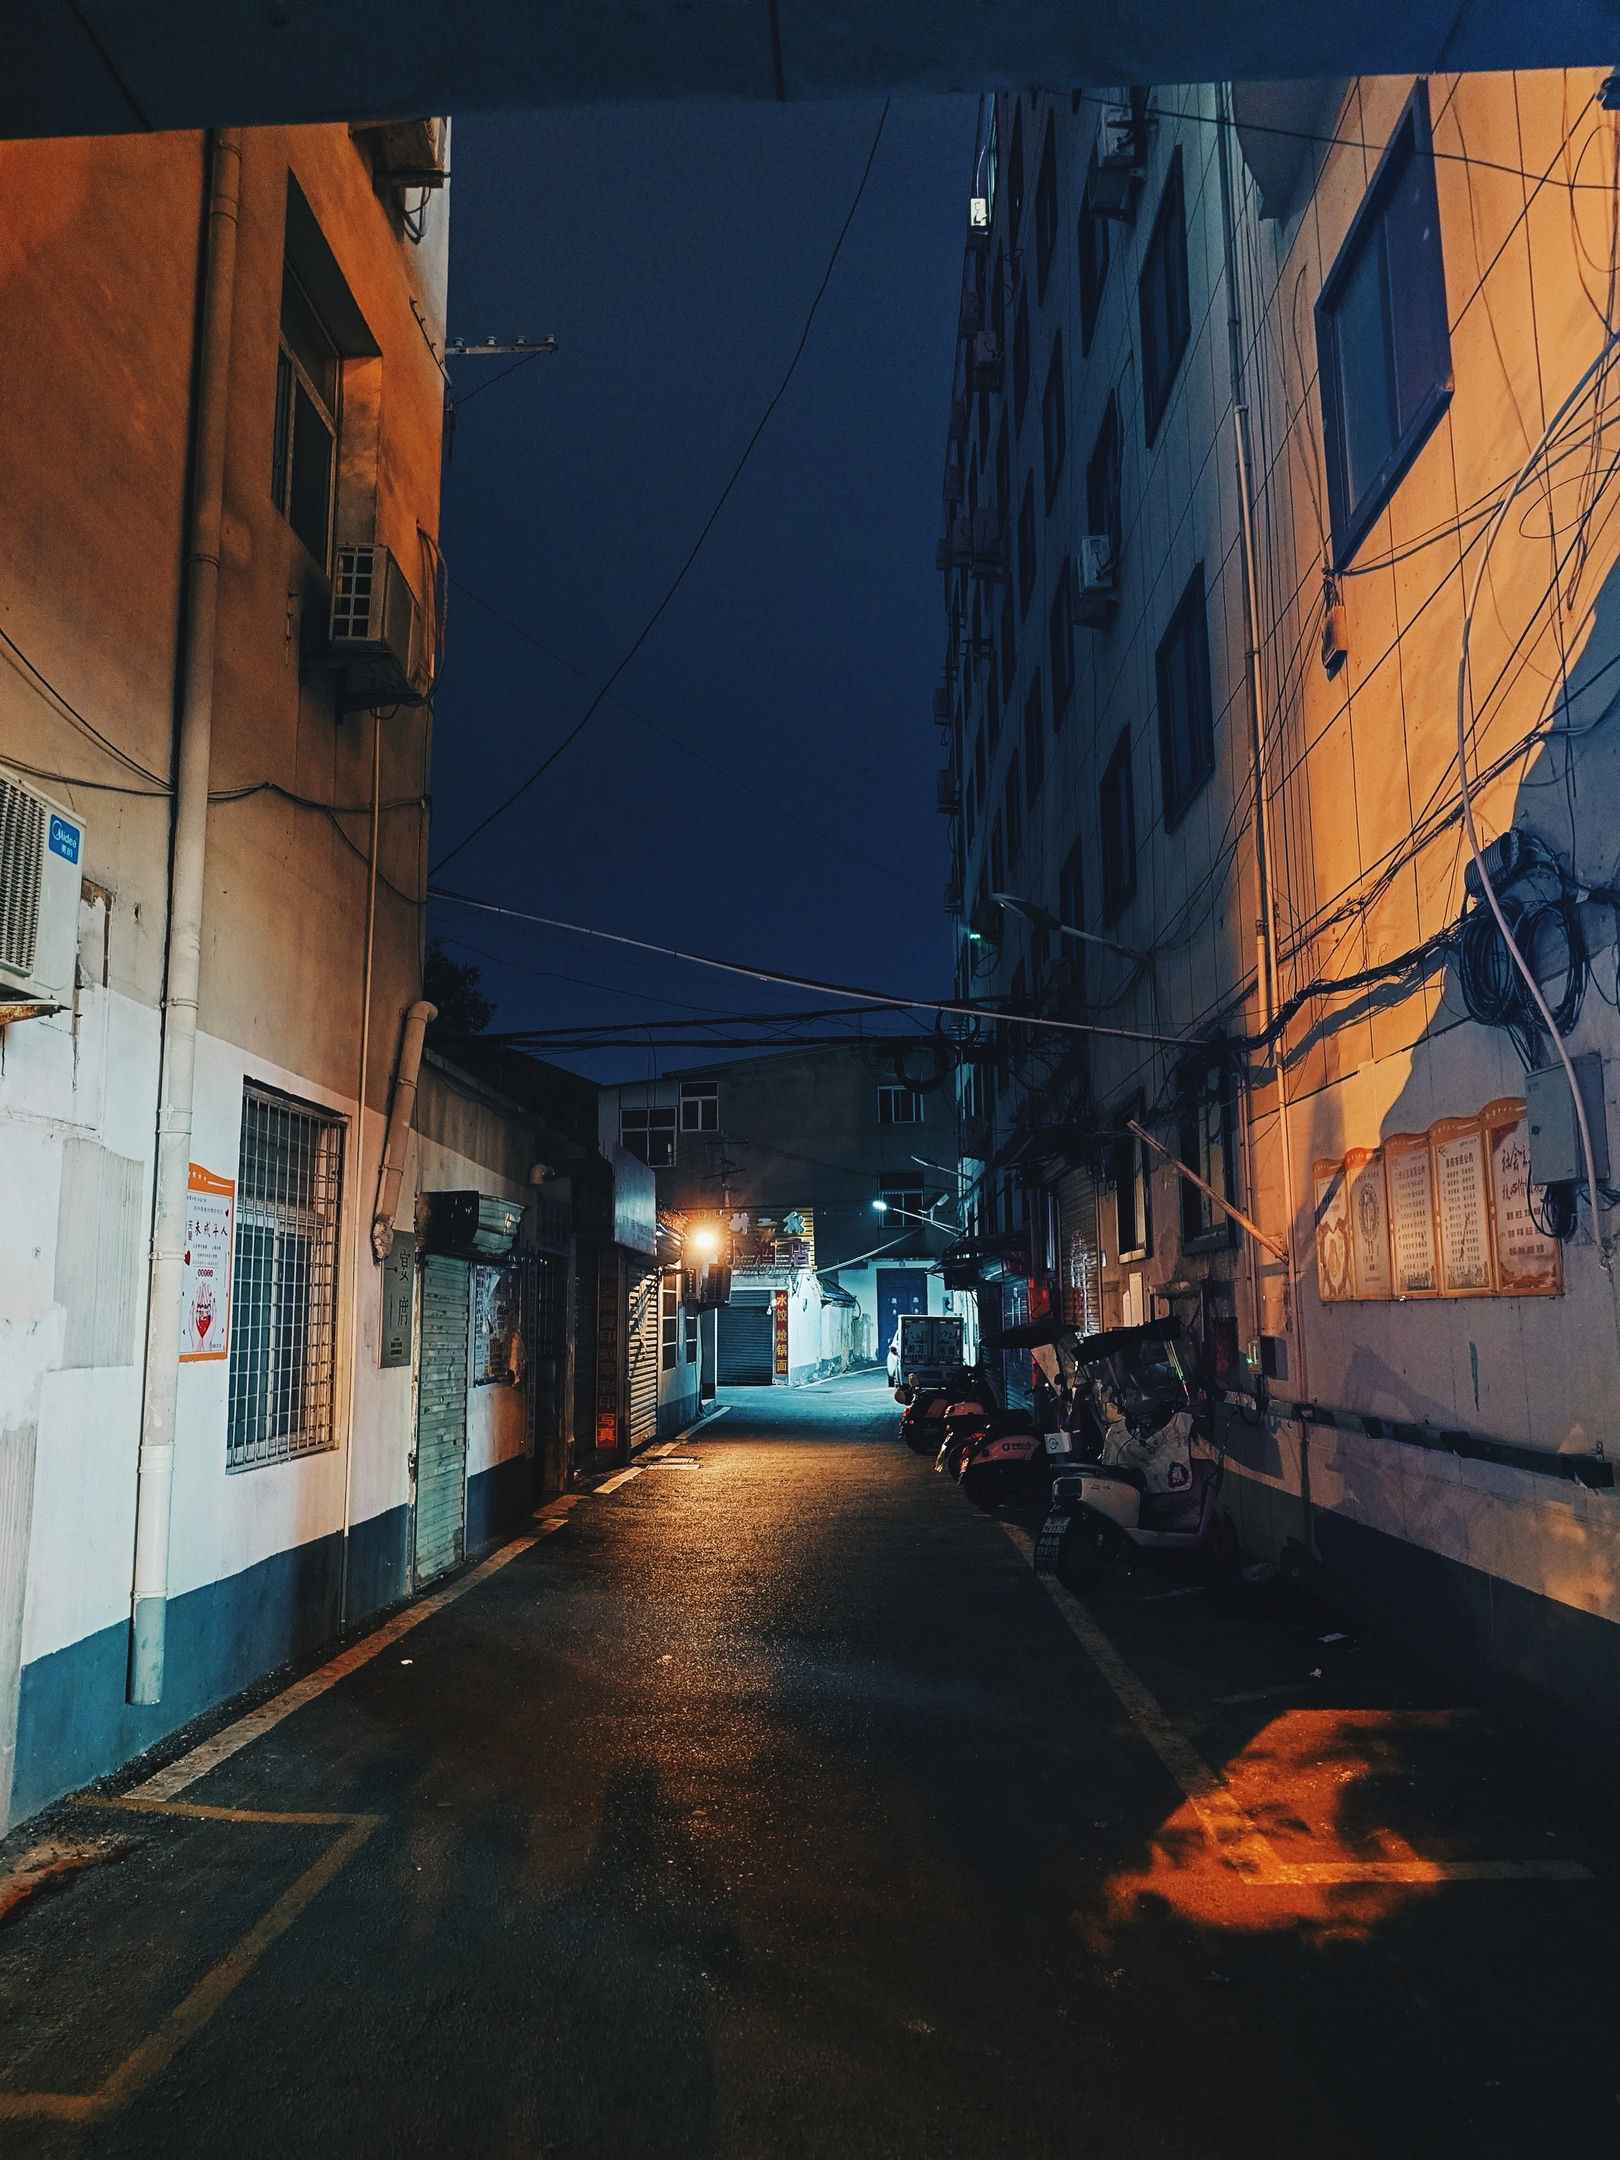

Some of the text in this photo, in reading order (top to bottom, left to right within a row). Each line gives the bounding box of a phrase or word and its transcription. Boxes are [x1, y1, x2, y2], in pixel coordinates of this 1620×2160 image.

[52, 820, 77, 848] Midea
[1501, 1142, 1530, 1173] 社会主
[194, 1220, 228, 1239] 未成年人
[776, 1294, 788, 1321] 水饺
[598, 1413, 617, 1441] 写真
